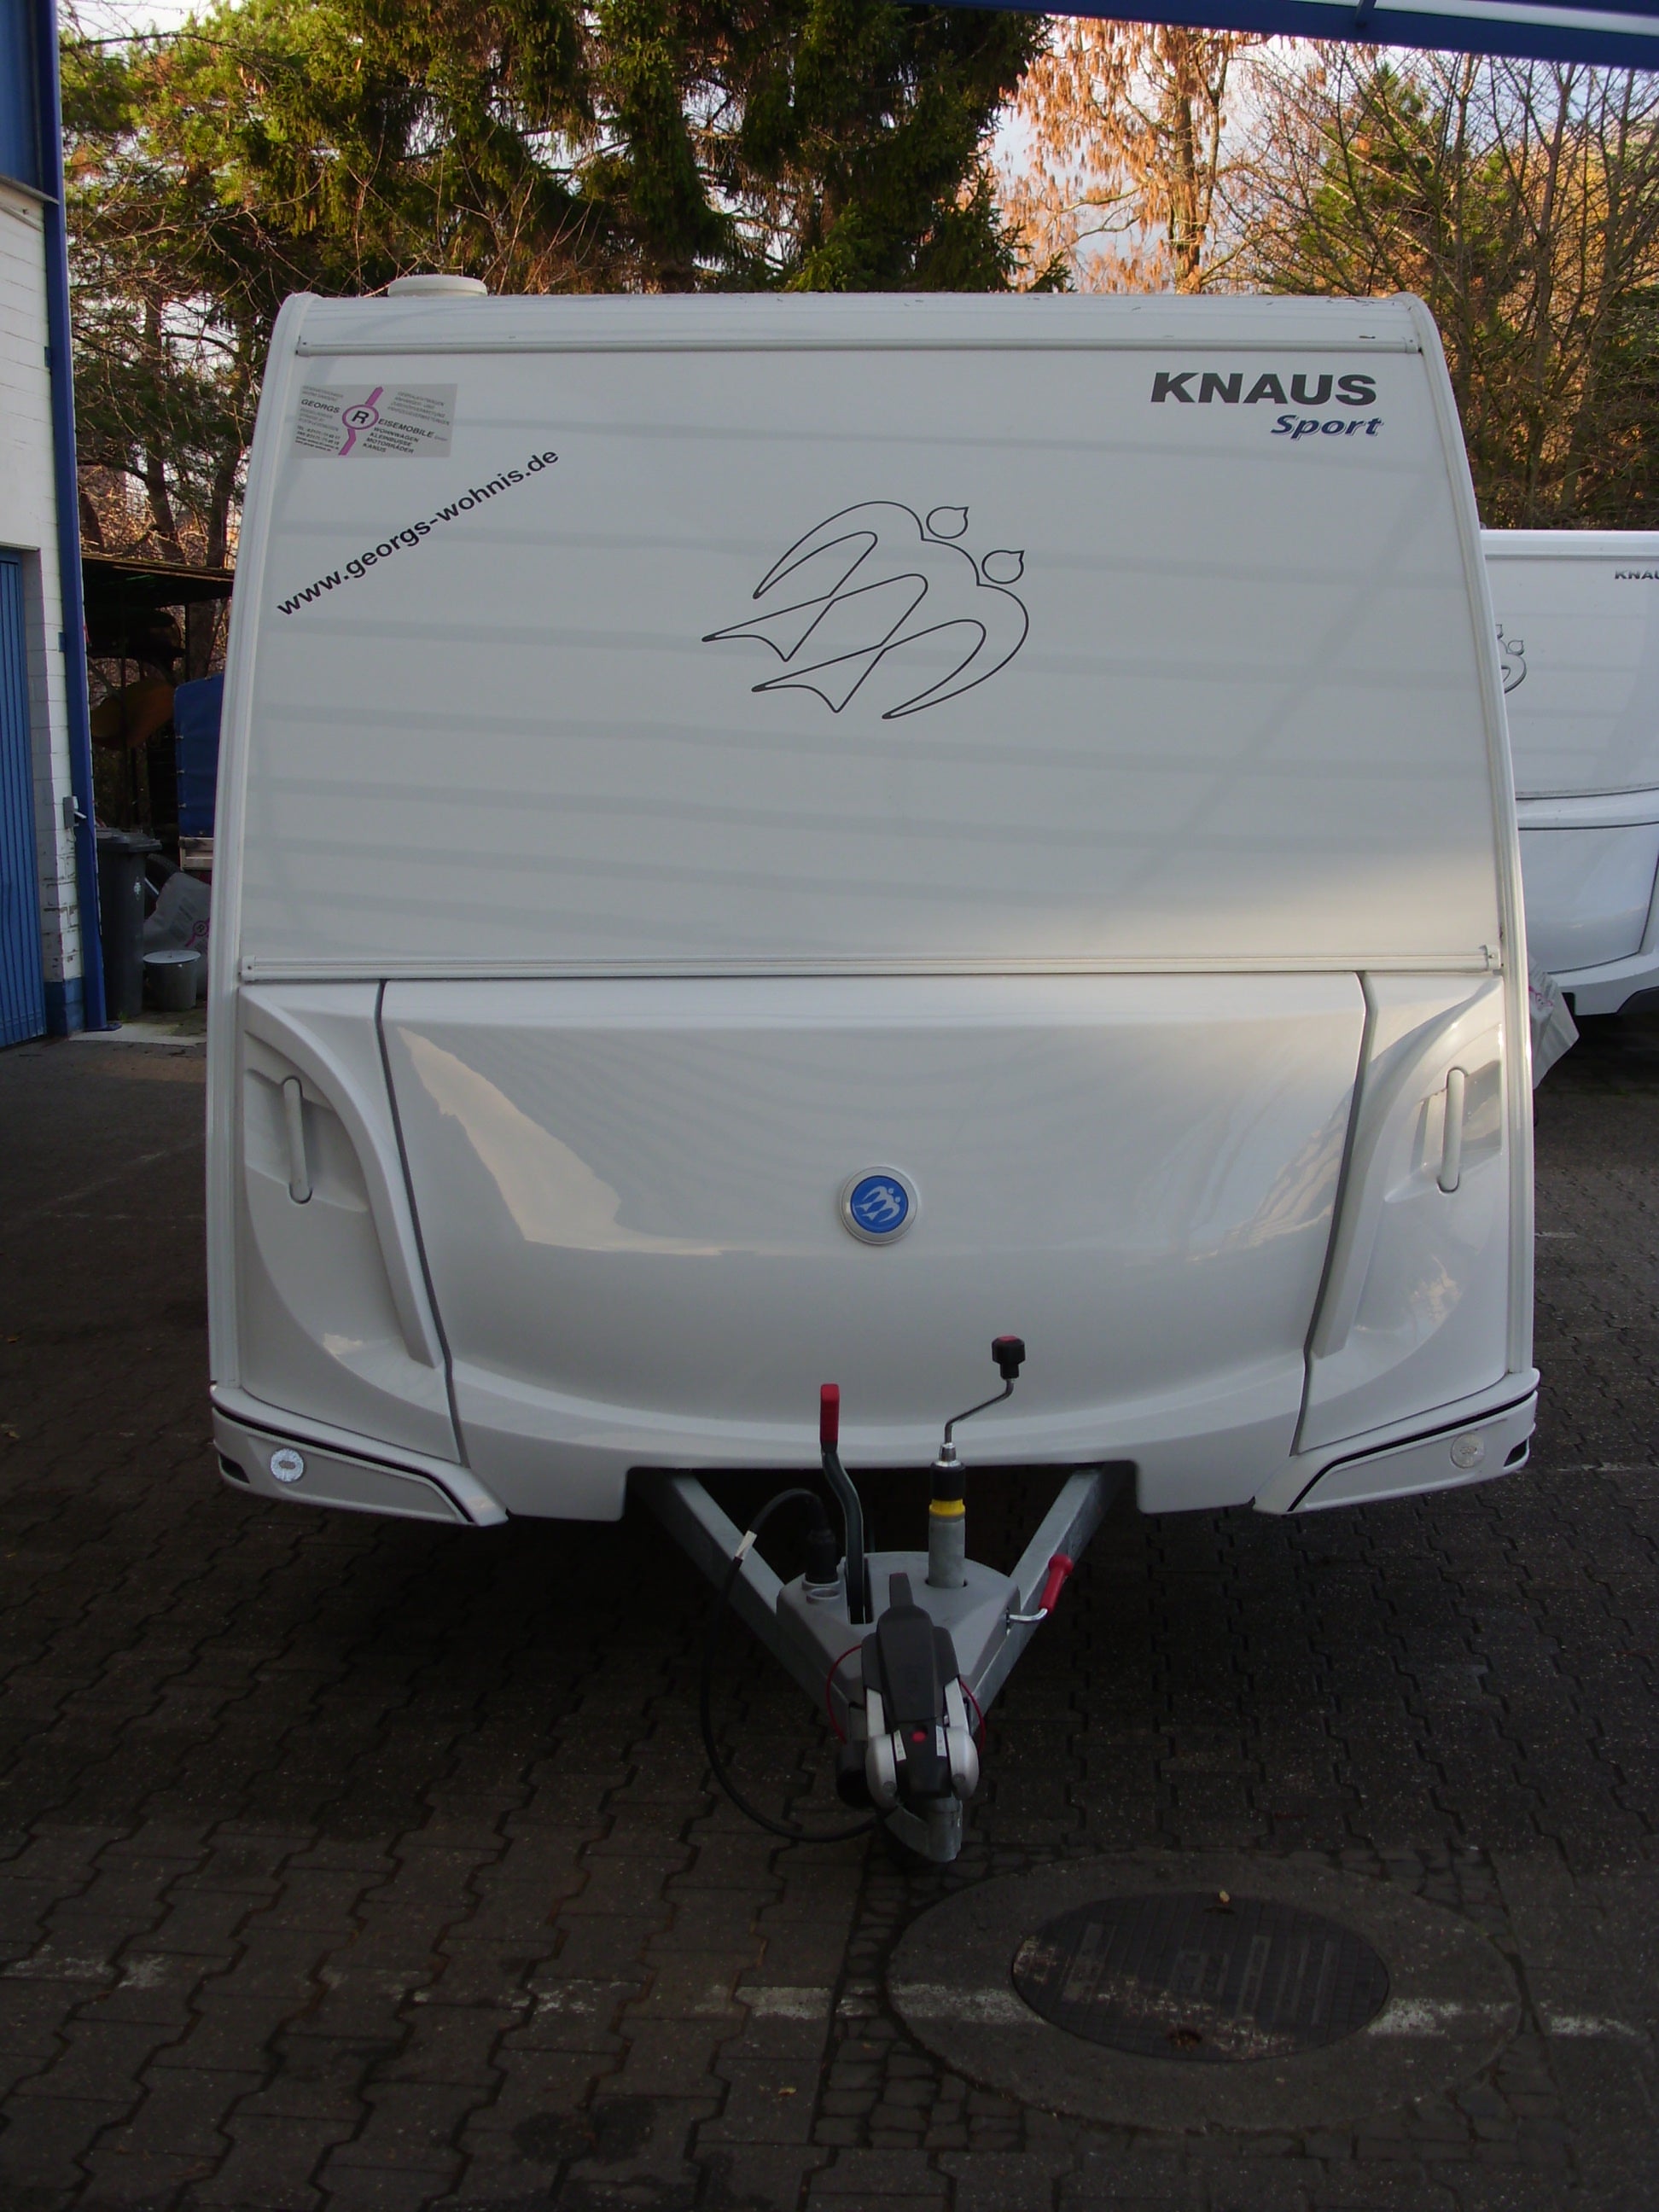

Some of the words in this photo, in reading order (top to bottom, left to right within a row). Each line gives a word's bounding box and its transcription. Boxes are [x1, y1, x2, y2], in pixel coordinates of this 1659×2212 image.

[1150, 372, 1377, 406] KNAUS
[300, 399, 341, 414] GEORGS
[352, 410, 370, 424] R
[378, 418, 435, 438] EISEMOBILE
[1270, 414, 1384, 441] Sport
[362, 443, 387, 453] KANUS
[370, 432, 412, 447] KLEINBUSSE
[374, 427, 420, 443] WOHNWAGEN
[276, 451, 559, 616] www.georgs-wohnis.de
